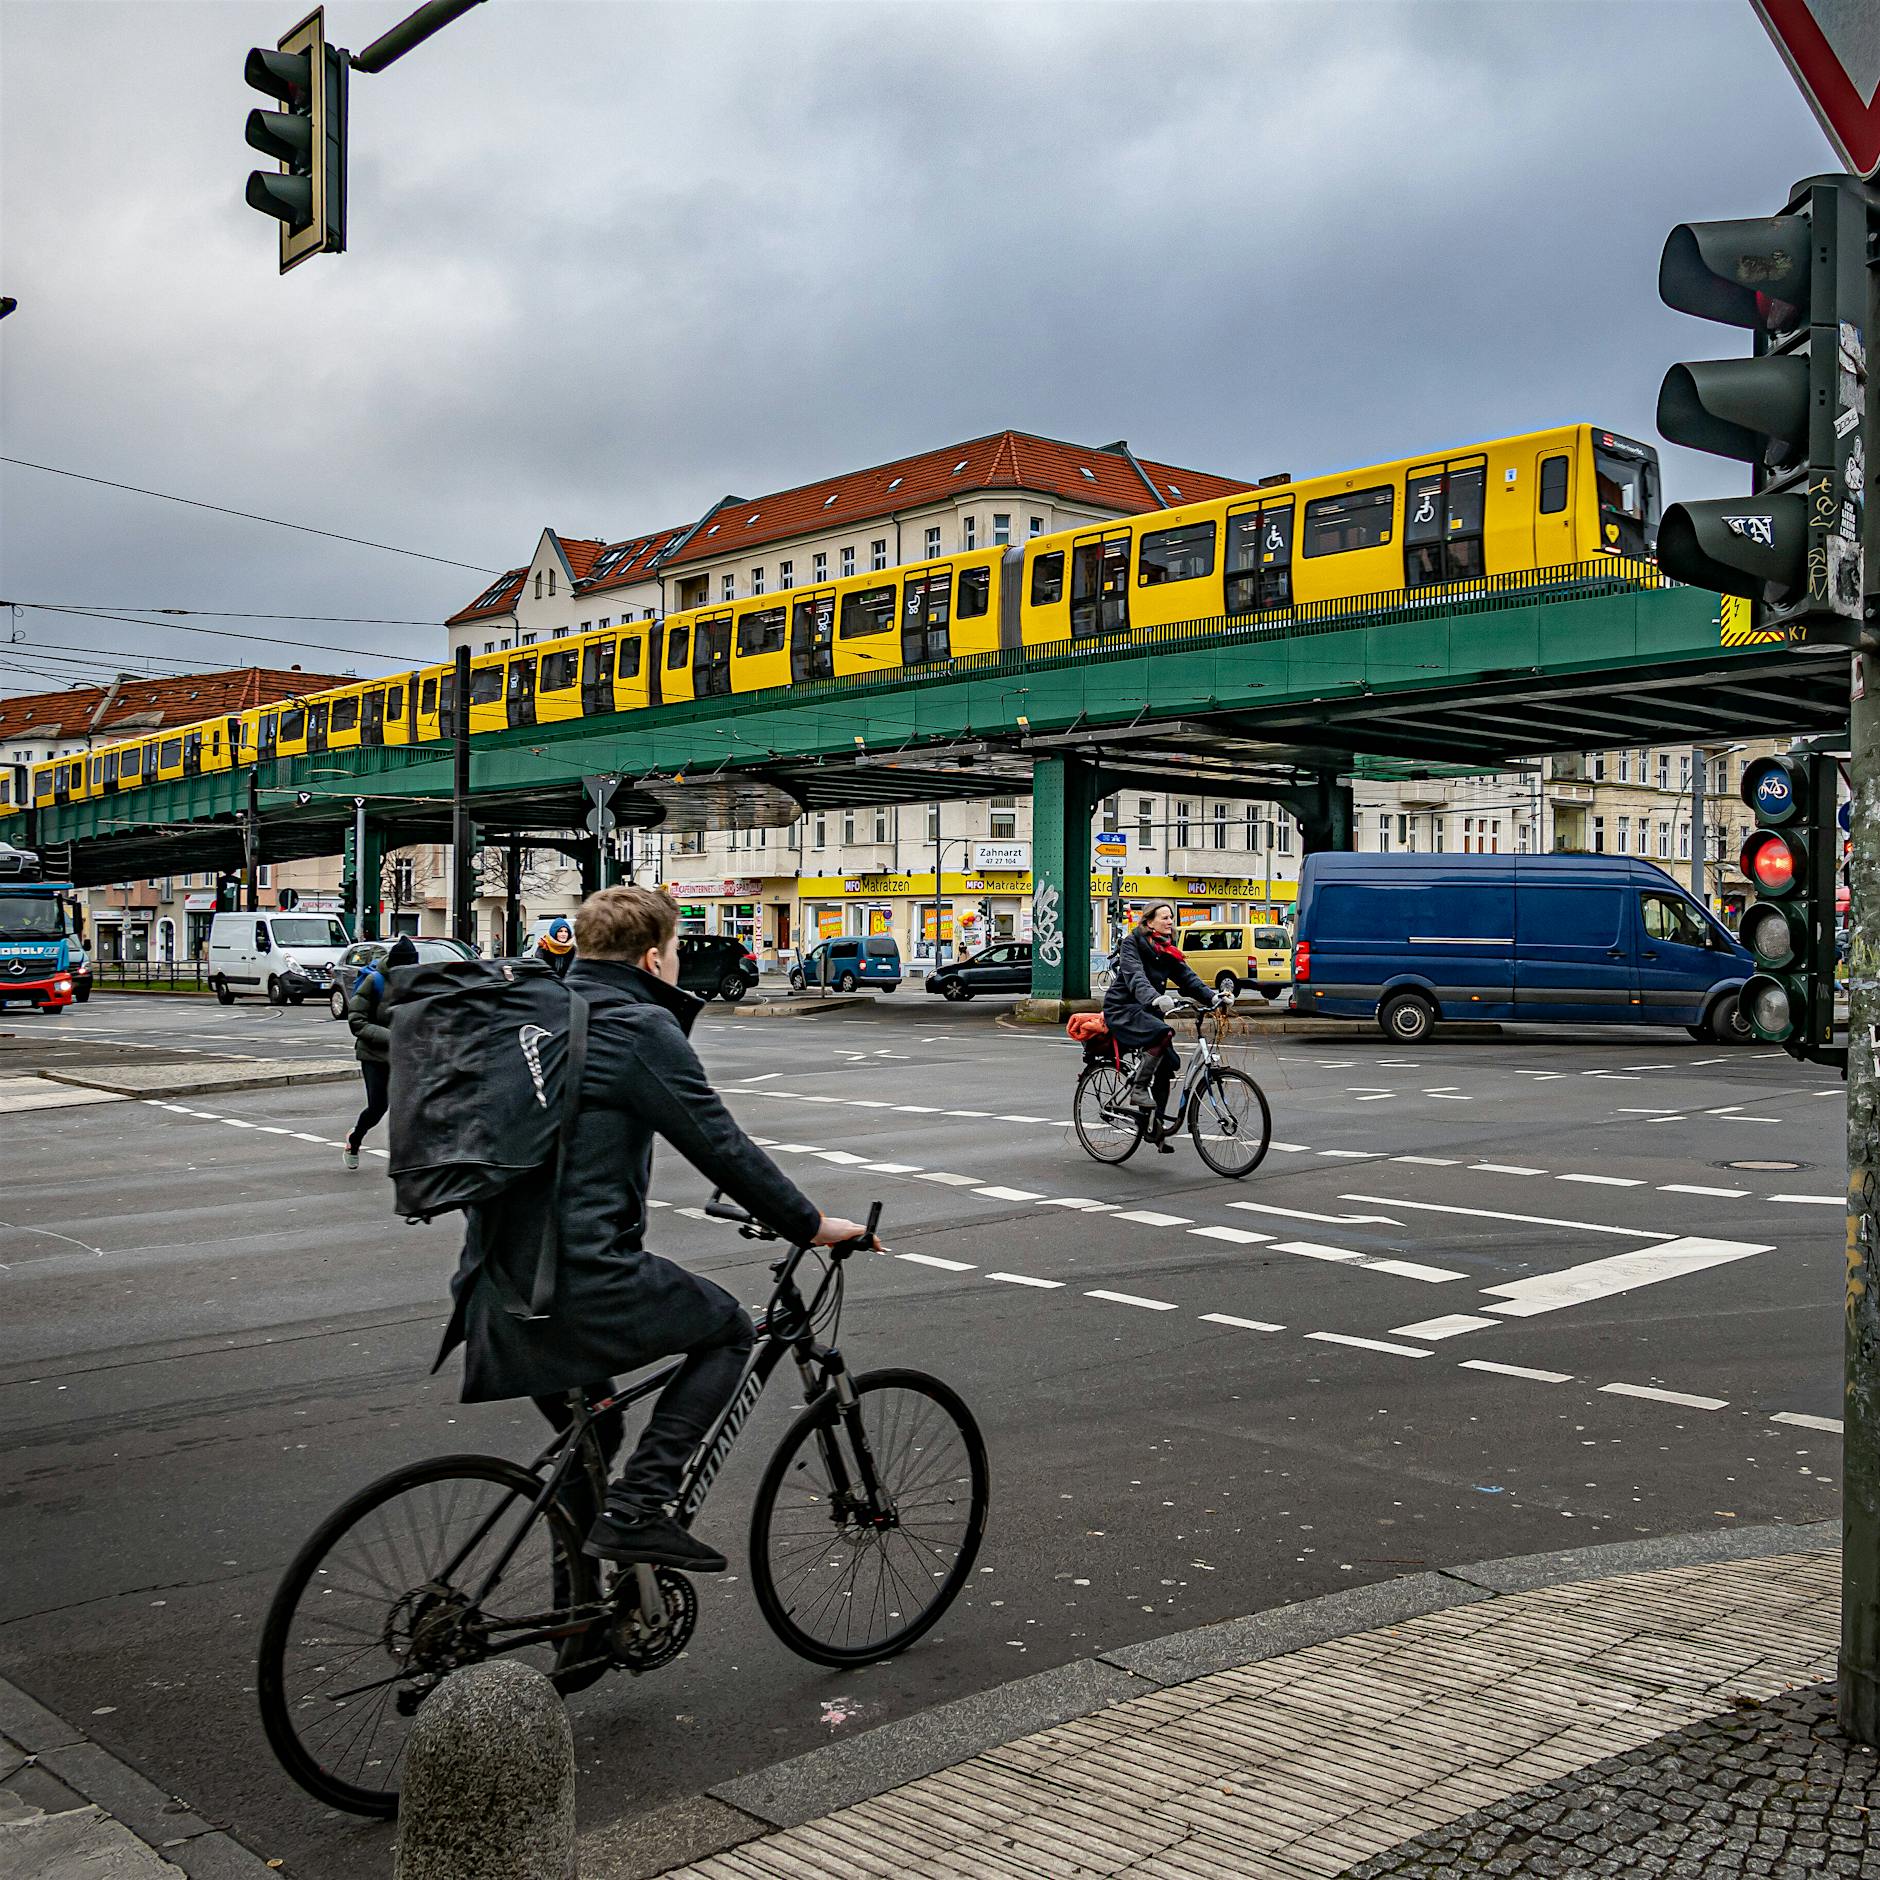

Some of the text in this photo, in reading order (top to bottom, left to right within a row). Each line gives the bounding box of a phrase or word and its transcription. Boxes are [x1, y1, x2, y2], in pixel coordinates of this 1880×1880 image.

[980, 848, 1022, 857] Zahnarzt
[845, 878, 910, 892] MFO Matratzen
[966, 879, 1032, 891] MFO Matratze
[1188, 881, 1260, 896] MFO Matratzen
[1824, 1025, 1831, 1040] 3
[684, 1370, 763, 1515] SPECIALIZED
